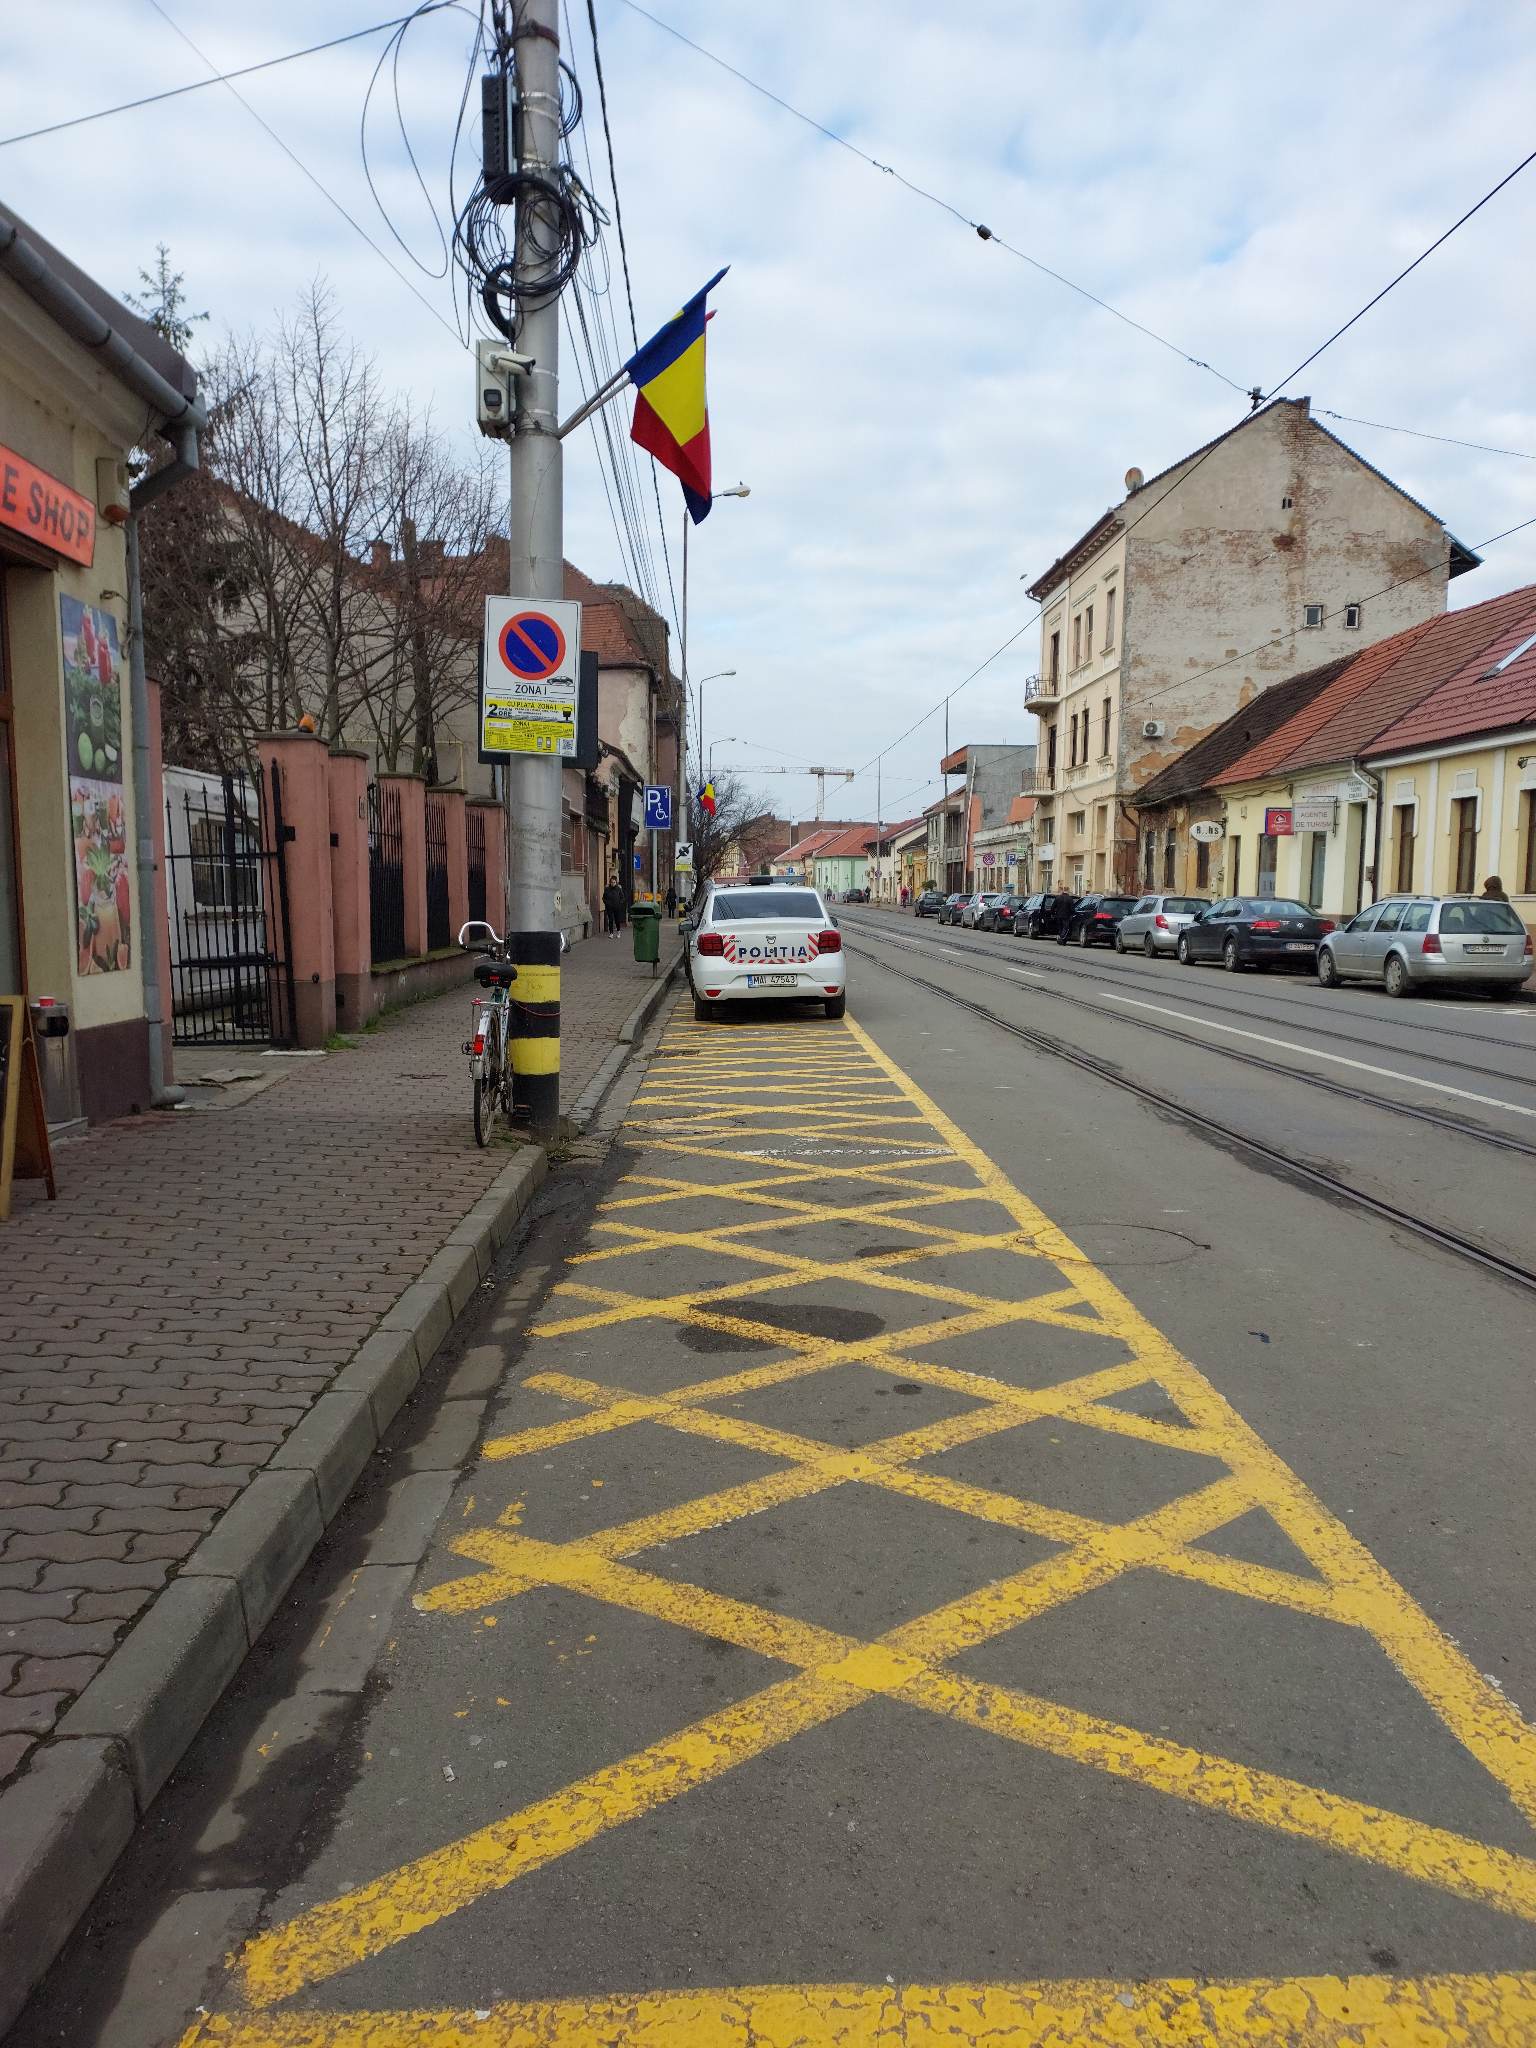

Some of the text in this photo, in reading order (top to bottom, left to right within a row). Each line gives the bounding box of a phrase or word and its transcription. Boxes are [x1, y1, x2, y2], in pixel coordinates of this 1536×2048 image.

[27, 481, 90, 548] SHOP
[515, 684, 541, 695] ZONA
[489, 704, 498, 716] 2
[647, 790, 660, 811] P
[754, 975, 795, 984] MAI 47543
